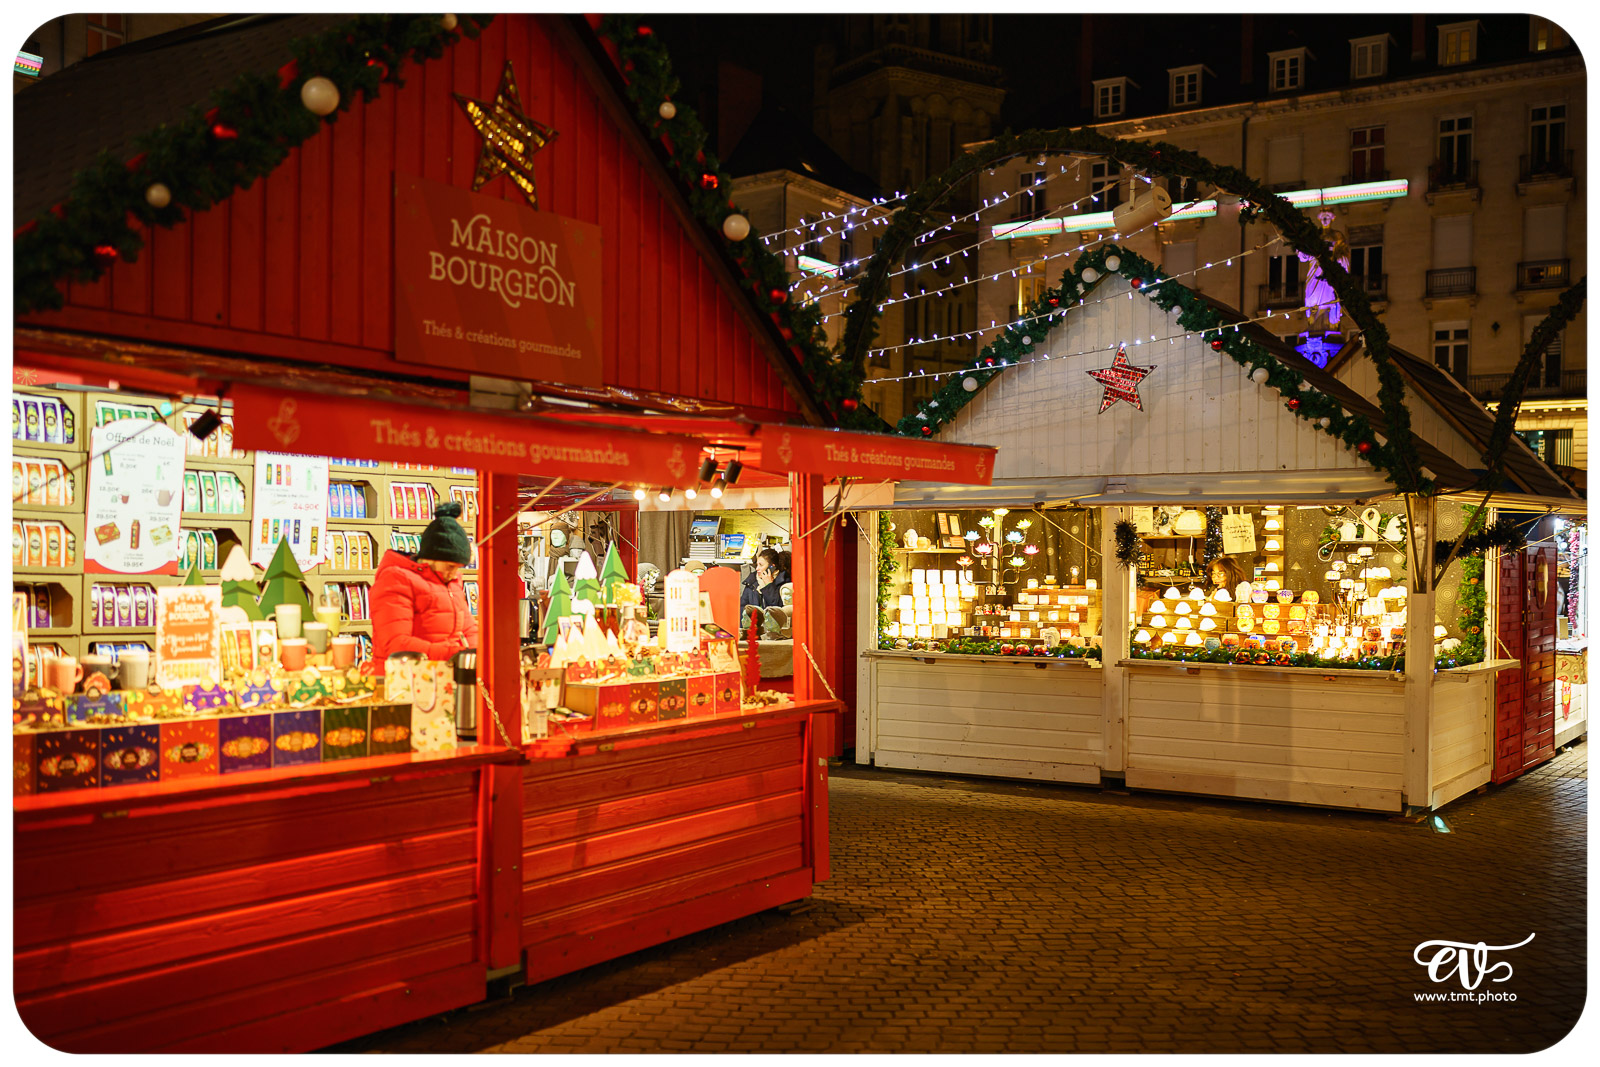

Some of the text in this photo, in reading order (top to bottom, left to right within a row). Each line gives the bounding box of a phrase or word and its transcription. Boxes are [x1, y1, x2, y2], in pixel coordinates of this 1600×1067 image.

[450, 214, 558, 268] MAISON
[428, 251, 576, 309] BOURGEON
[423, 319, 582, 360] Thés & créations gourmandes
[105, 432, 175, 447] Offres de Noël
[370, 418, 630, 466] Thés & créations gourmandes
[824, 443, 956, 471] Thés & créations gourmandes
